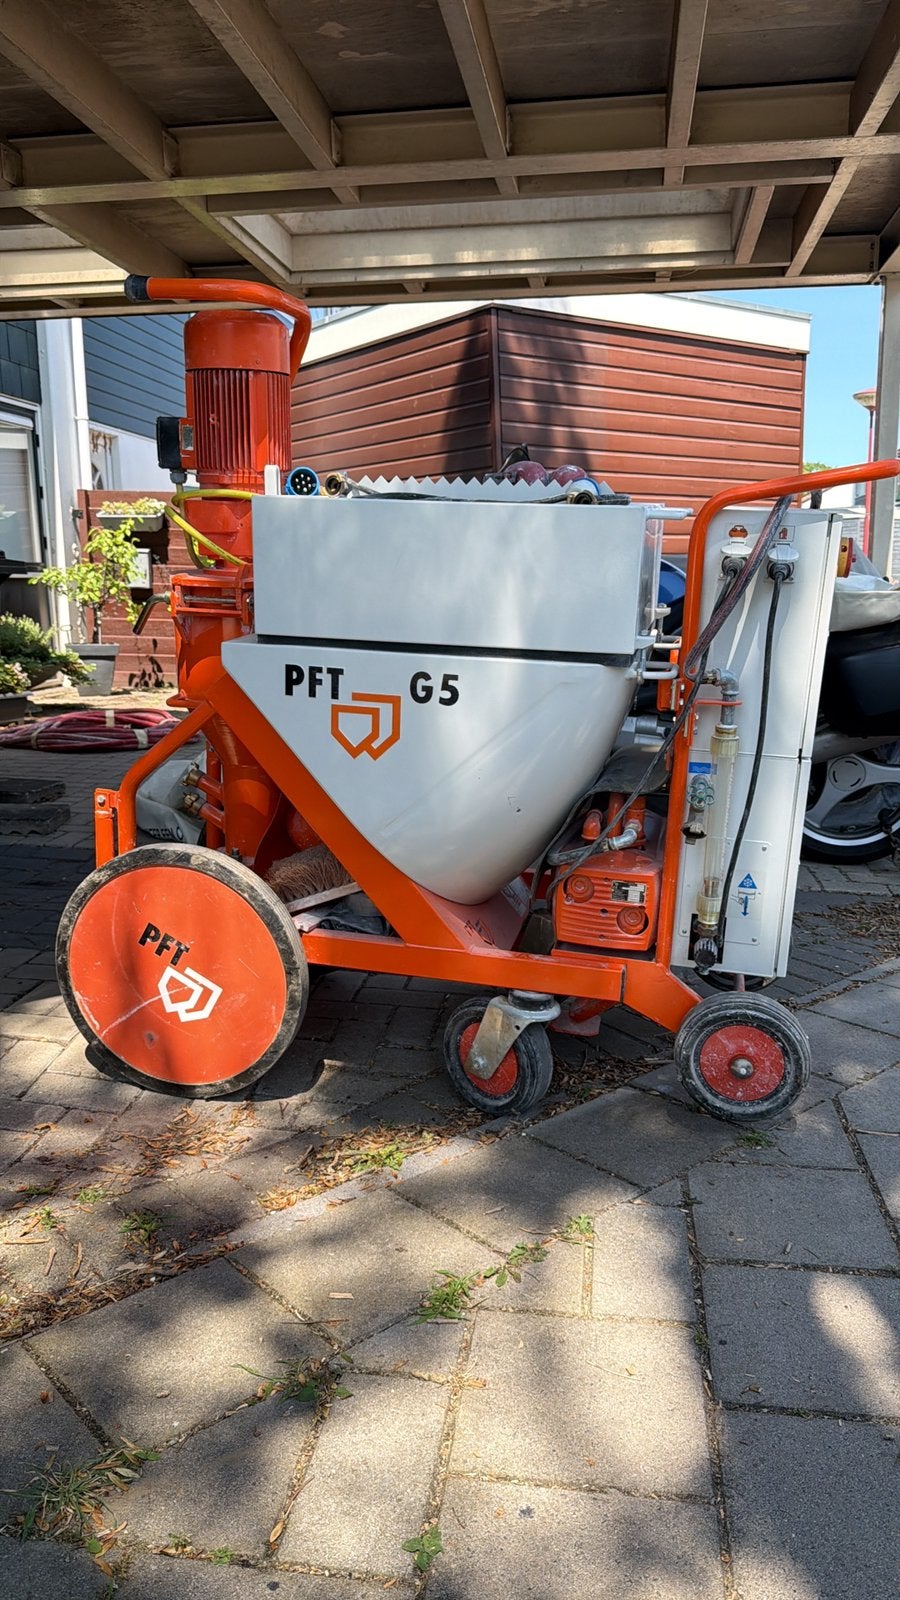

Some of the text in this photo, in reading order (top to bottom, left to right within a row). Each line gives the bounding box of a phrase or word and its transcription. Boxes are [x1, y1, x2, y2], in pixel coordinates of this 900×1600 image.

[285, 664, 459, 706] PFT G5
[138, 922, 190, 966] PFT
